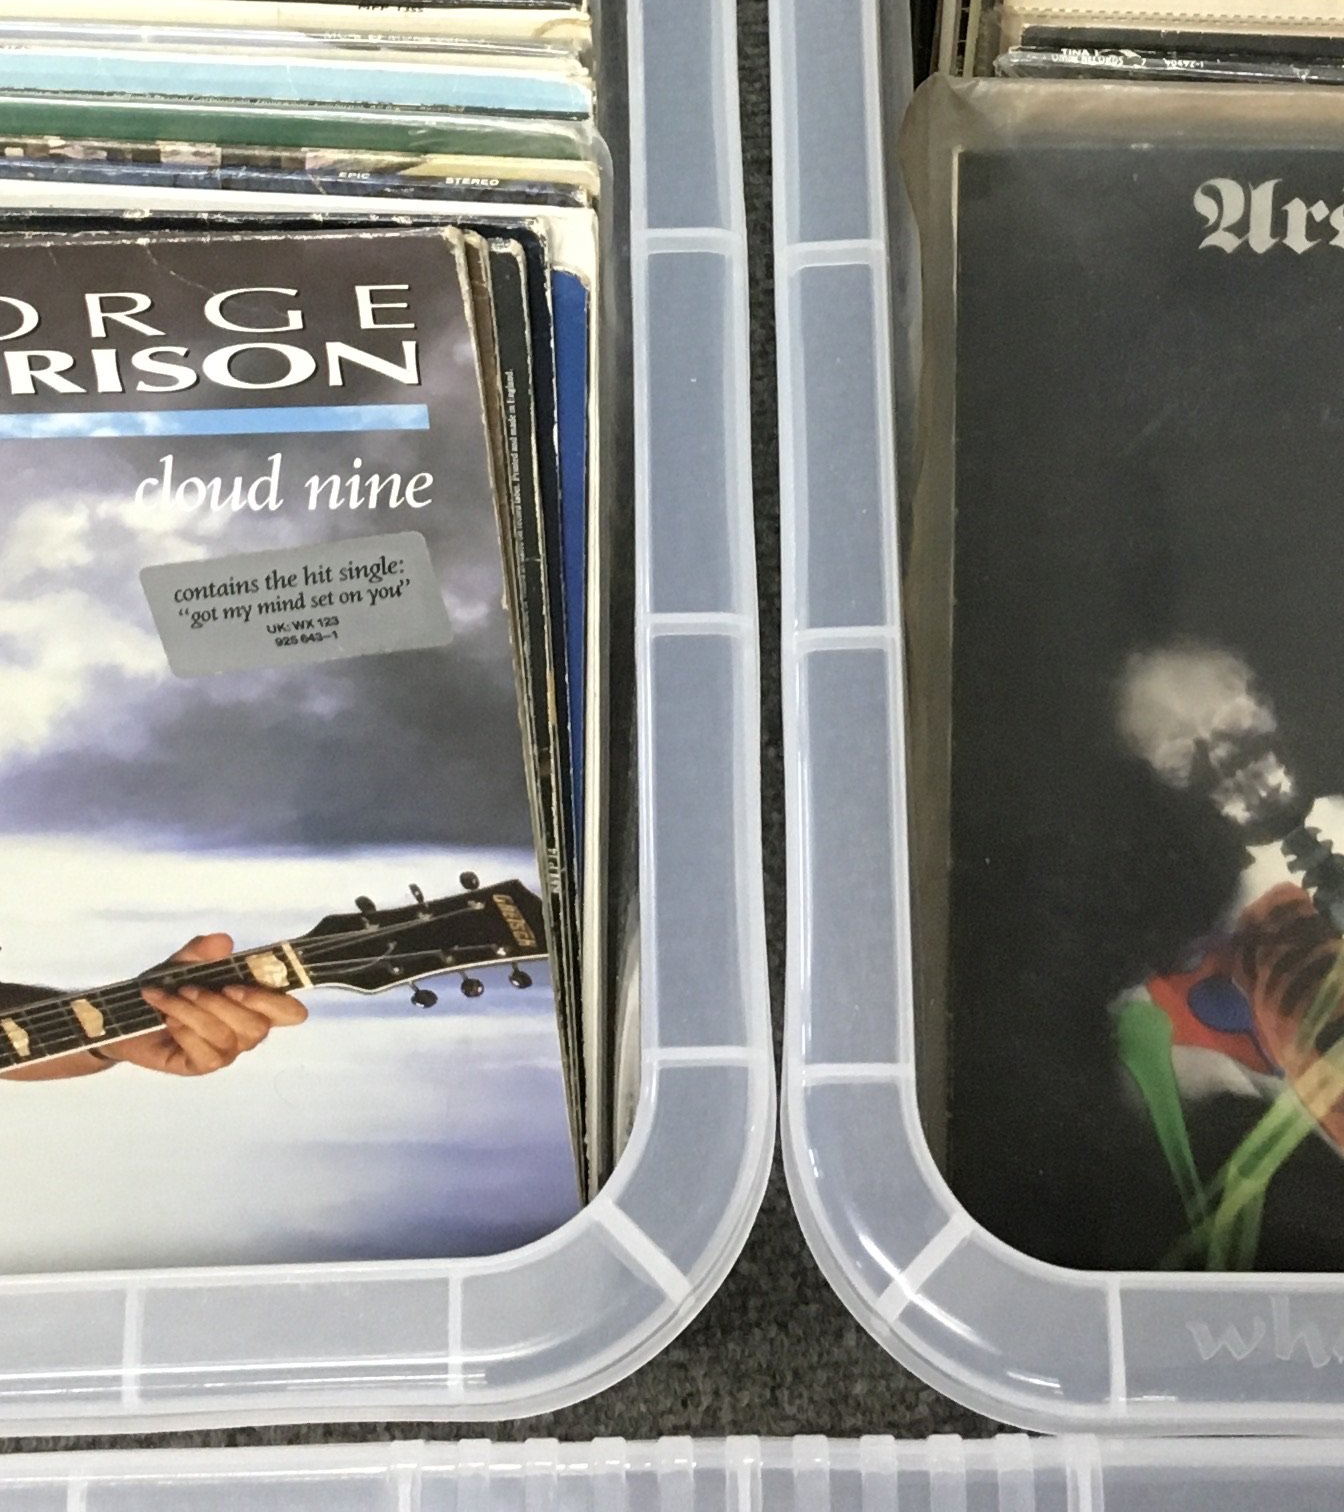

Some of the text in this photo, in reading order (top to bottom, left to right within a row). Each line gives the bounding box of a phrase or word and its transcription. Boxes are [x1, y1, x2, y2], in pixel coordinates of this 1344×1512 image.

[339, 172, 371, 180] EPIC
[445, 176, 500, 186] STEREO
[136, 455, 435, 514] cloud nine
[173, 557, 407, 604] contains the hit single:
[222, 602, 254, 623] my
[256, 595, 306, 616] mind
[310, 593, 336, 610] set
[339, 592, 364, 607] on
[266, 616, 340, 635] UK: WX 123
[274, 635, 298, 648] 925
